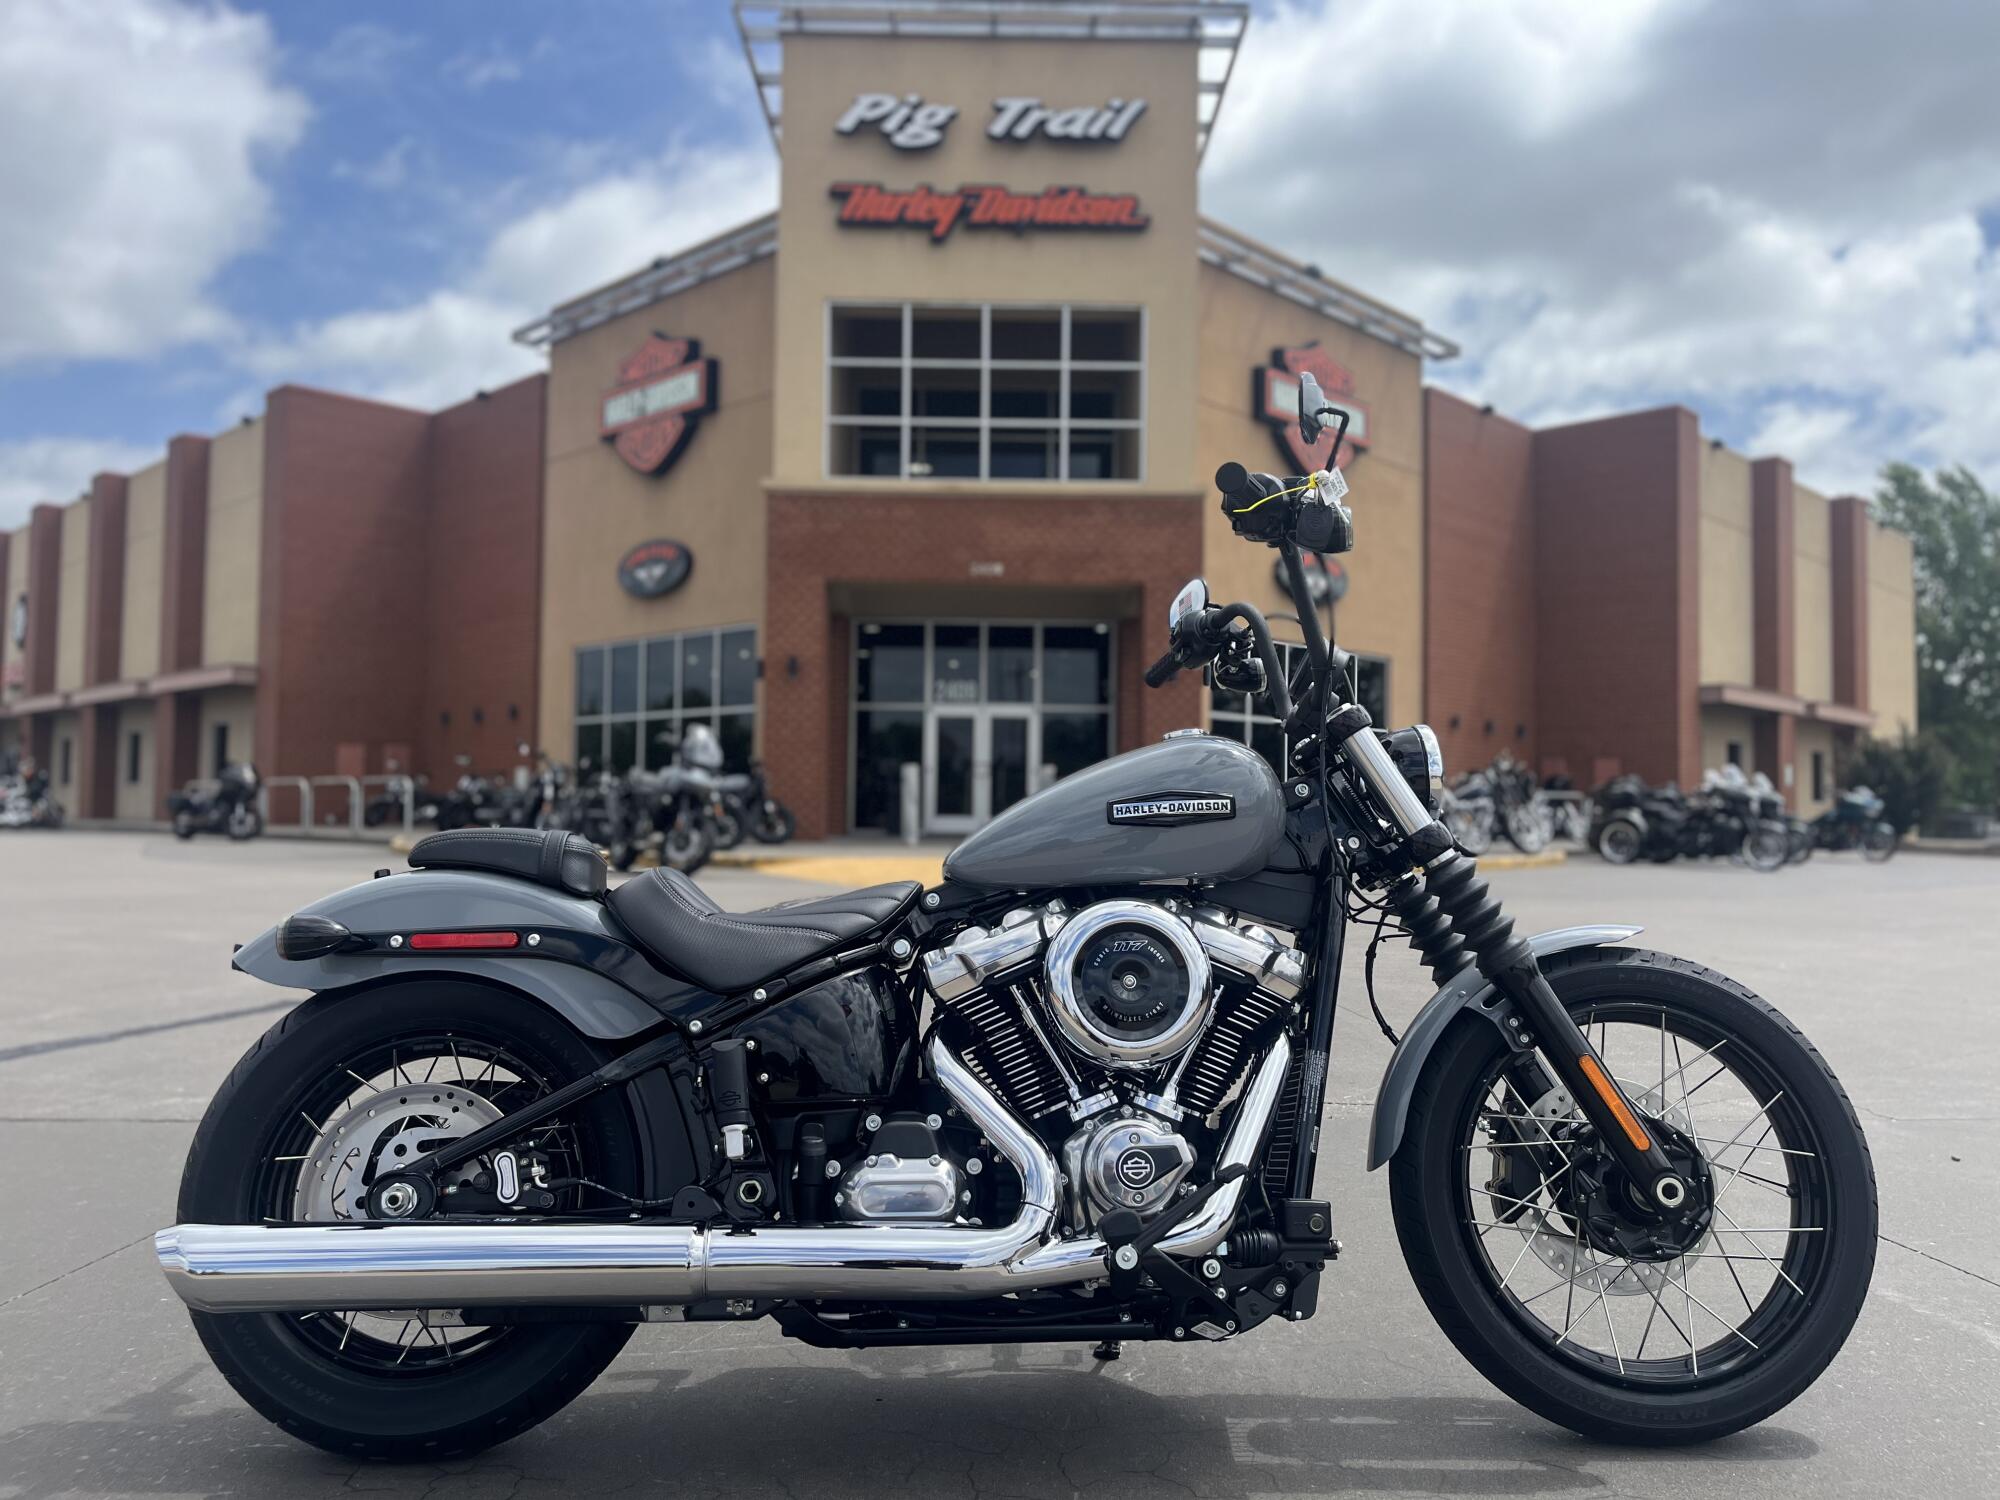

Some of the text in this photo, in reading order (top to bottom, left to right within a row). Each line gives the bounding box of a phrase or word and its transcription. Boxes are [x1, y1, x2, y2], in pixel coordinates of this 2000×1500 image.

[834, 94, 1147, 150] Pig Trail
[829, 184, 1151, 244] Harley-Davidson
[1115, 801, 1230, 816] HARLEY-DAVIDSON
[1112, 939, 1149, 952] 117
